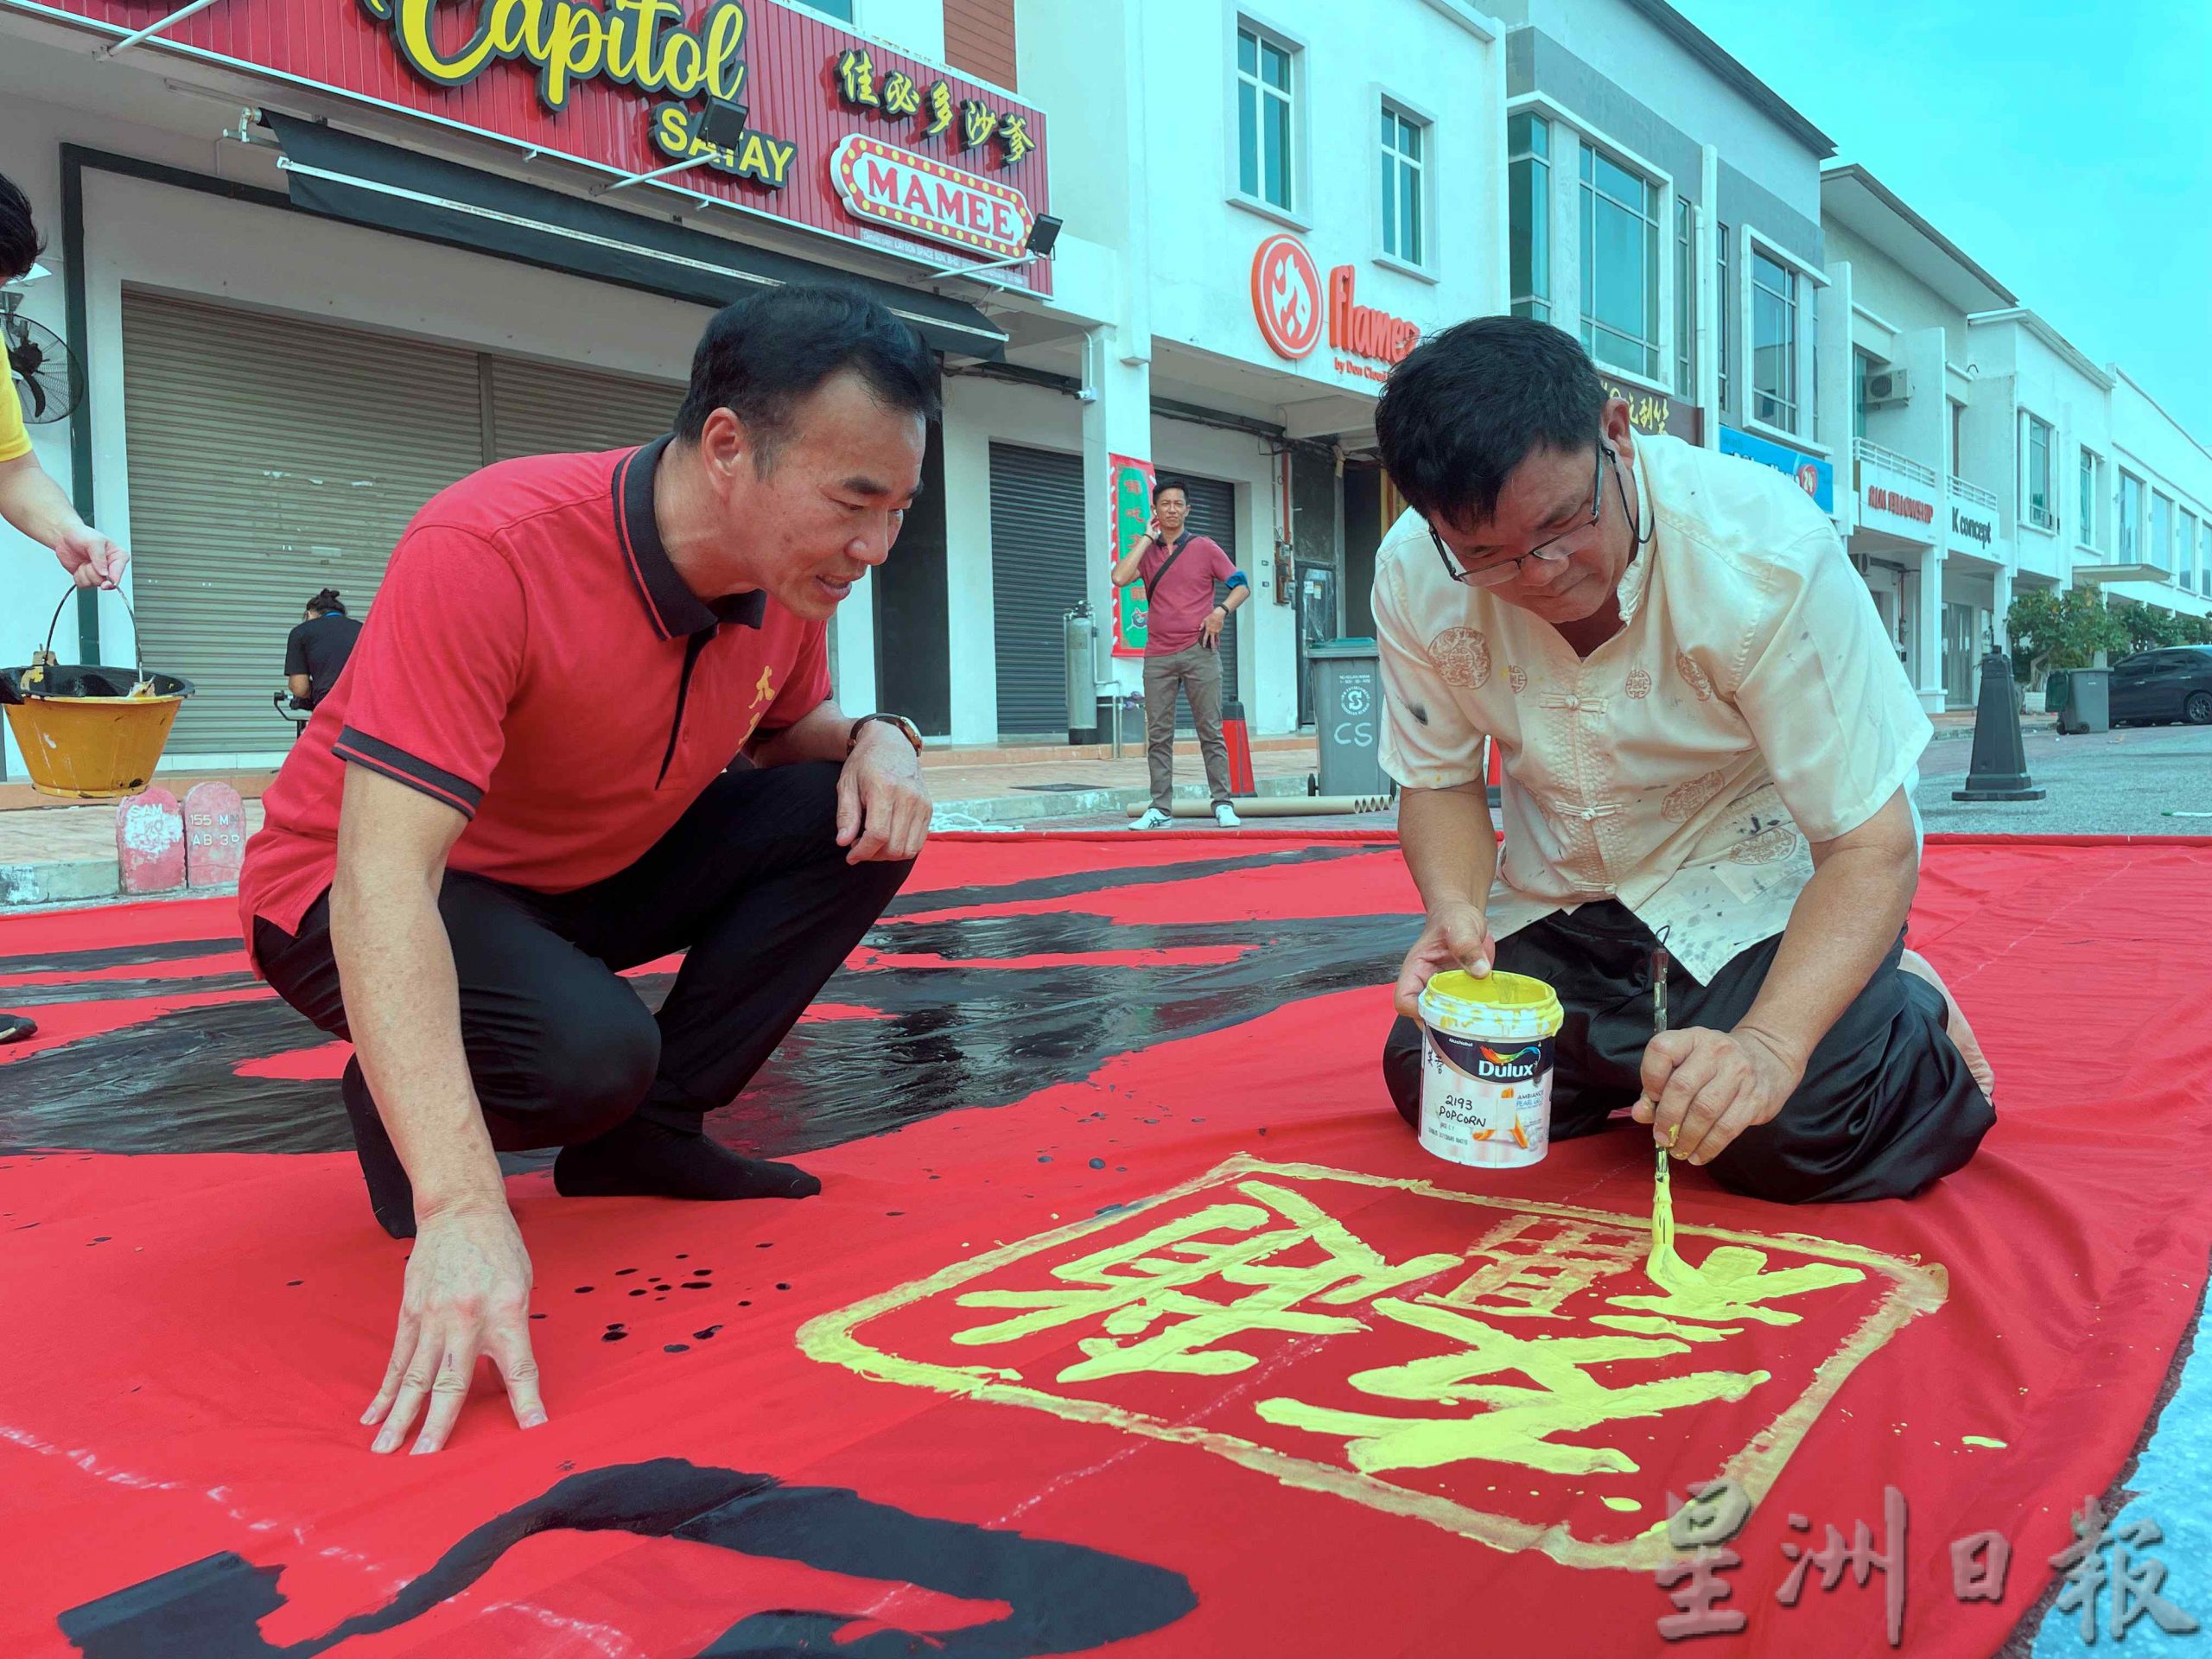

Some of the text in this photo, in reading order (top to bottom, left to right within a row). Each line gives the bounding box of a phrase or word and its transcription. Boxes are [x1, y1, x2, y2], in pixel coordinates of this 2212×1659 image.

[399, 0, 745, 106] Capitol
[659, 107, 794, 182] SAY
[867, 159, 1016, 242] MAMEE
[1952, 506, 1992, 550] K concept
[1334, 721, 1373, 747] CS
[189, 814, 212, 826] 155
[193, 834, 213, 846] AB
[1478, 1060, 1534, 1077] Dulux
[1445, 1095, 1473, 1110] 2193
[1439, 1106, 1486, 1128] POPCORN
